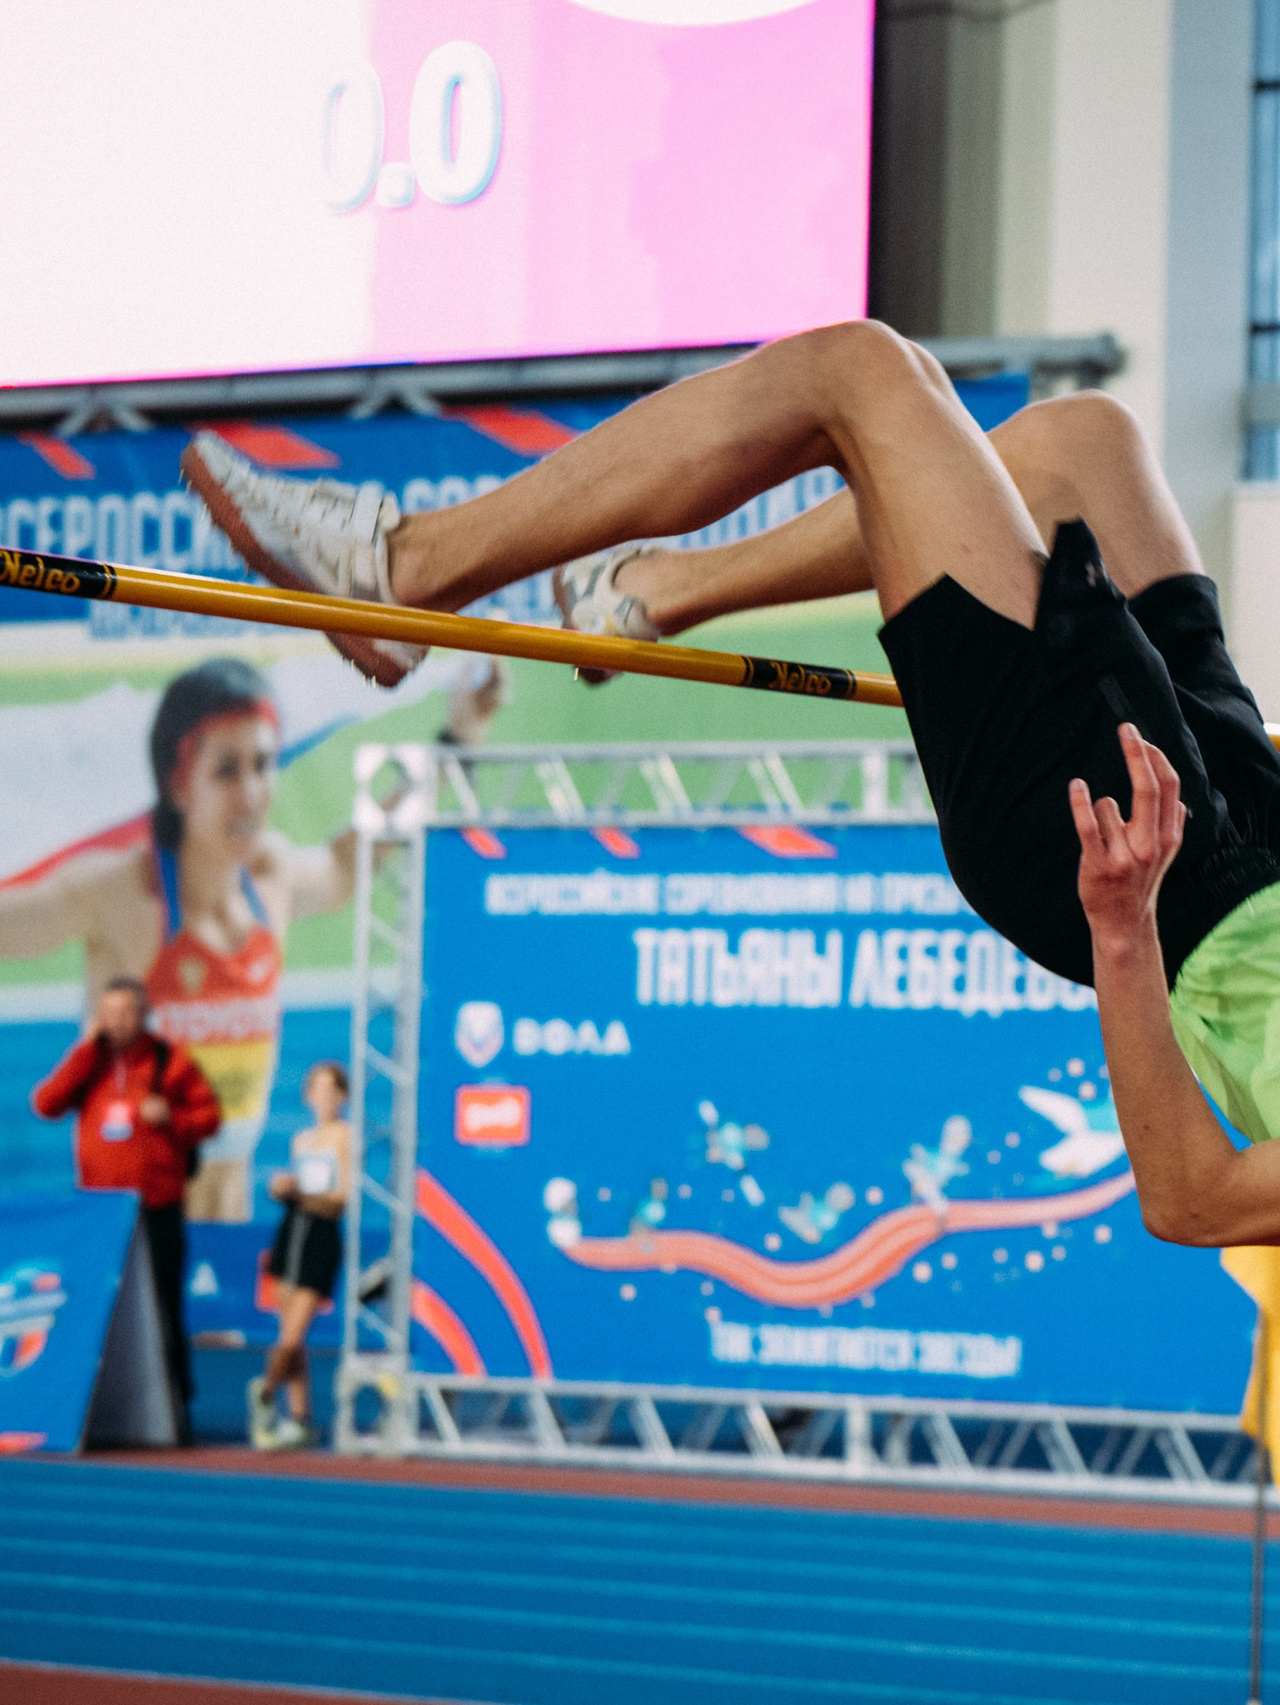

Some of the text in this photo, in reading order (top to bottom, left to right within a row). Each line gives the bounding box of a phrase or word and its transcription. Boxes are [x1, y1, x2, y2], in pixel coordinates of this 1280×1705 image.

[318, 40, 503, 213] 0.0
[768, 660, 832, 695] Nelco
[633, 928, 844, 1007] ТАТЬЯНЫ
